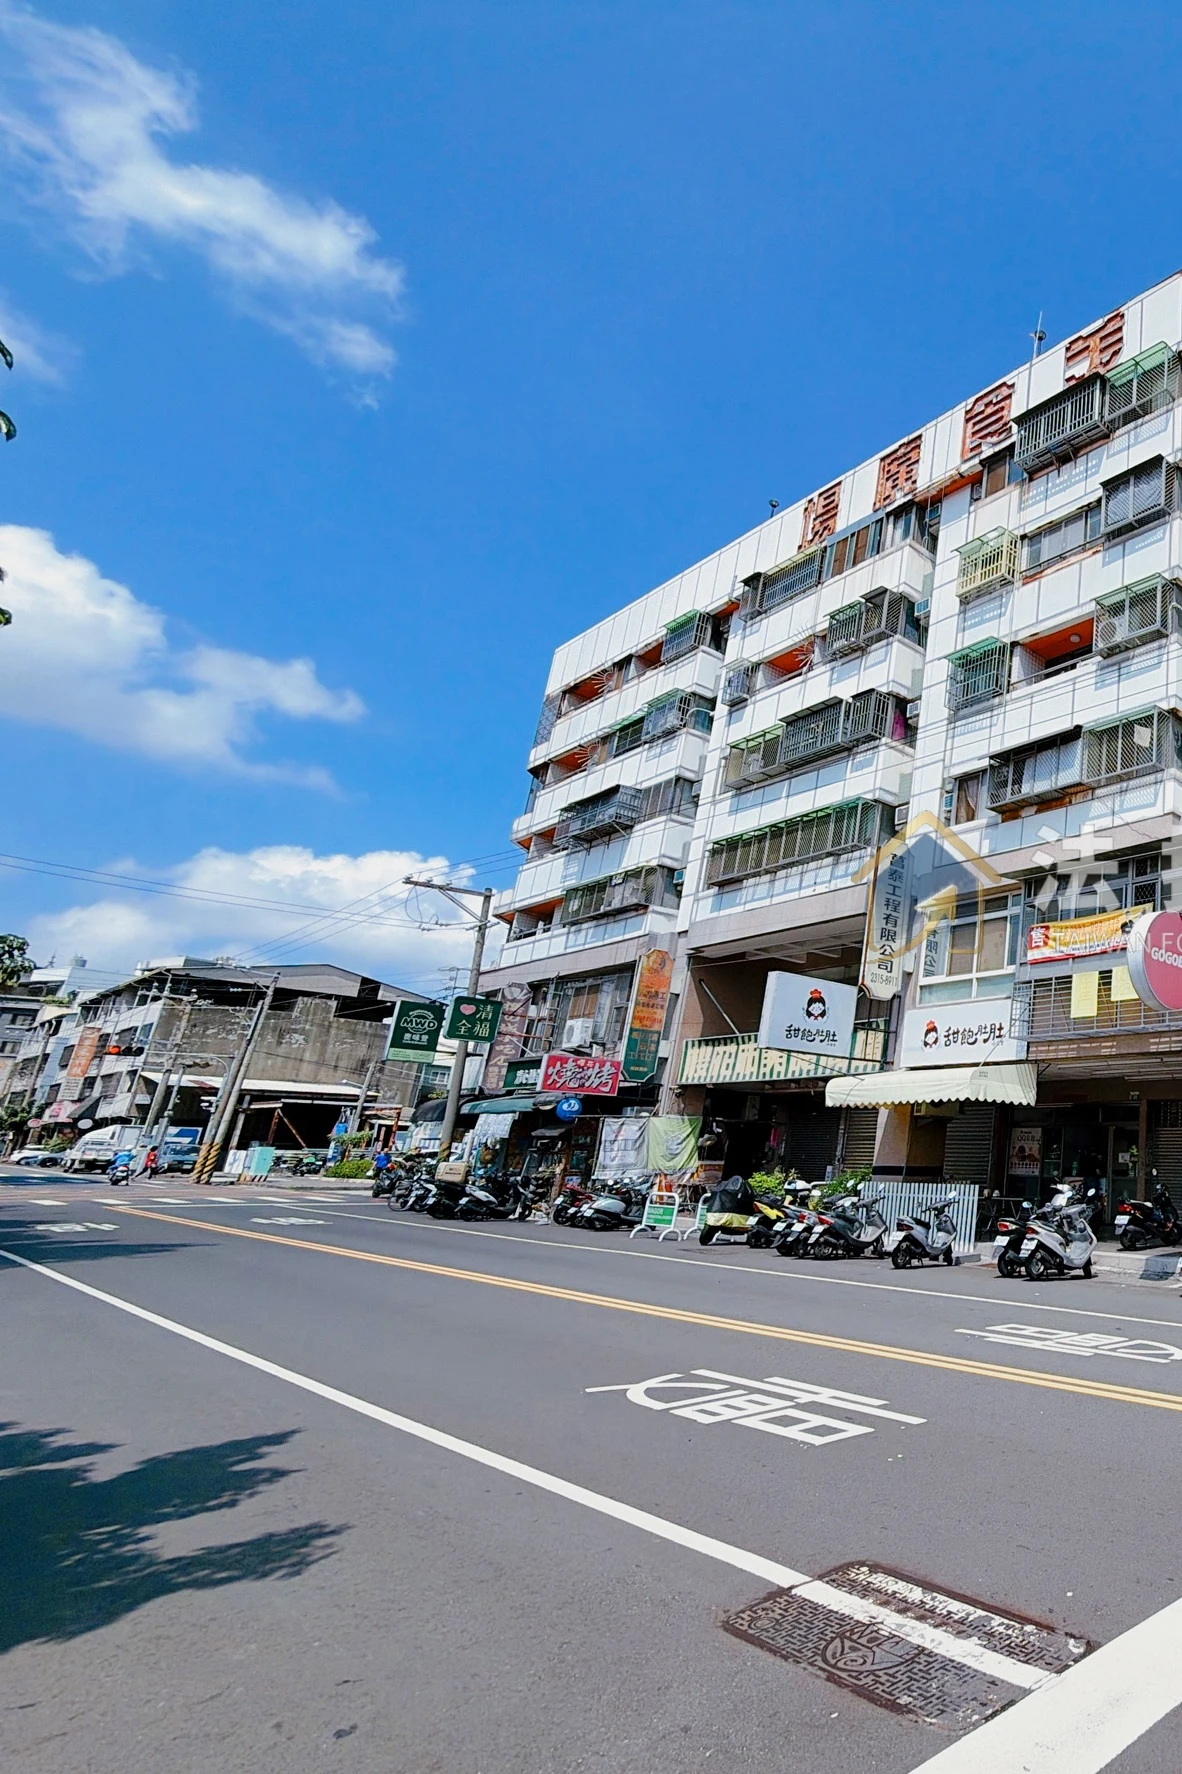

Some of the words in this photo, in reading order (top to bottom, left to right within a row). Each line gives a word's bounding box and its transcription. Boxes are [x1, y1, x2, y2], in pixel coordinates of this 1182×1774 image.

[1030, 925, 1047, 948] 售
[400, 1016, 438, 1030] MWD
[943, 1022, 1005, 1047] 甜飽肚肚
